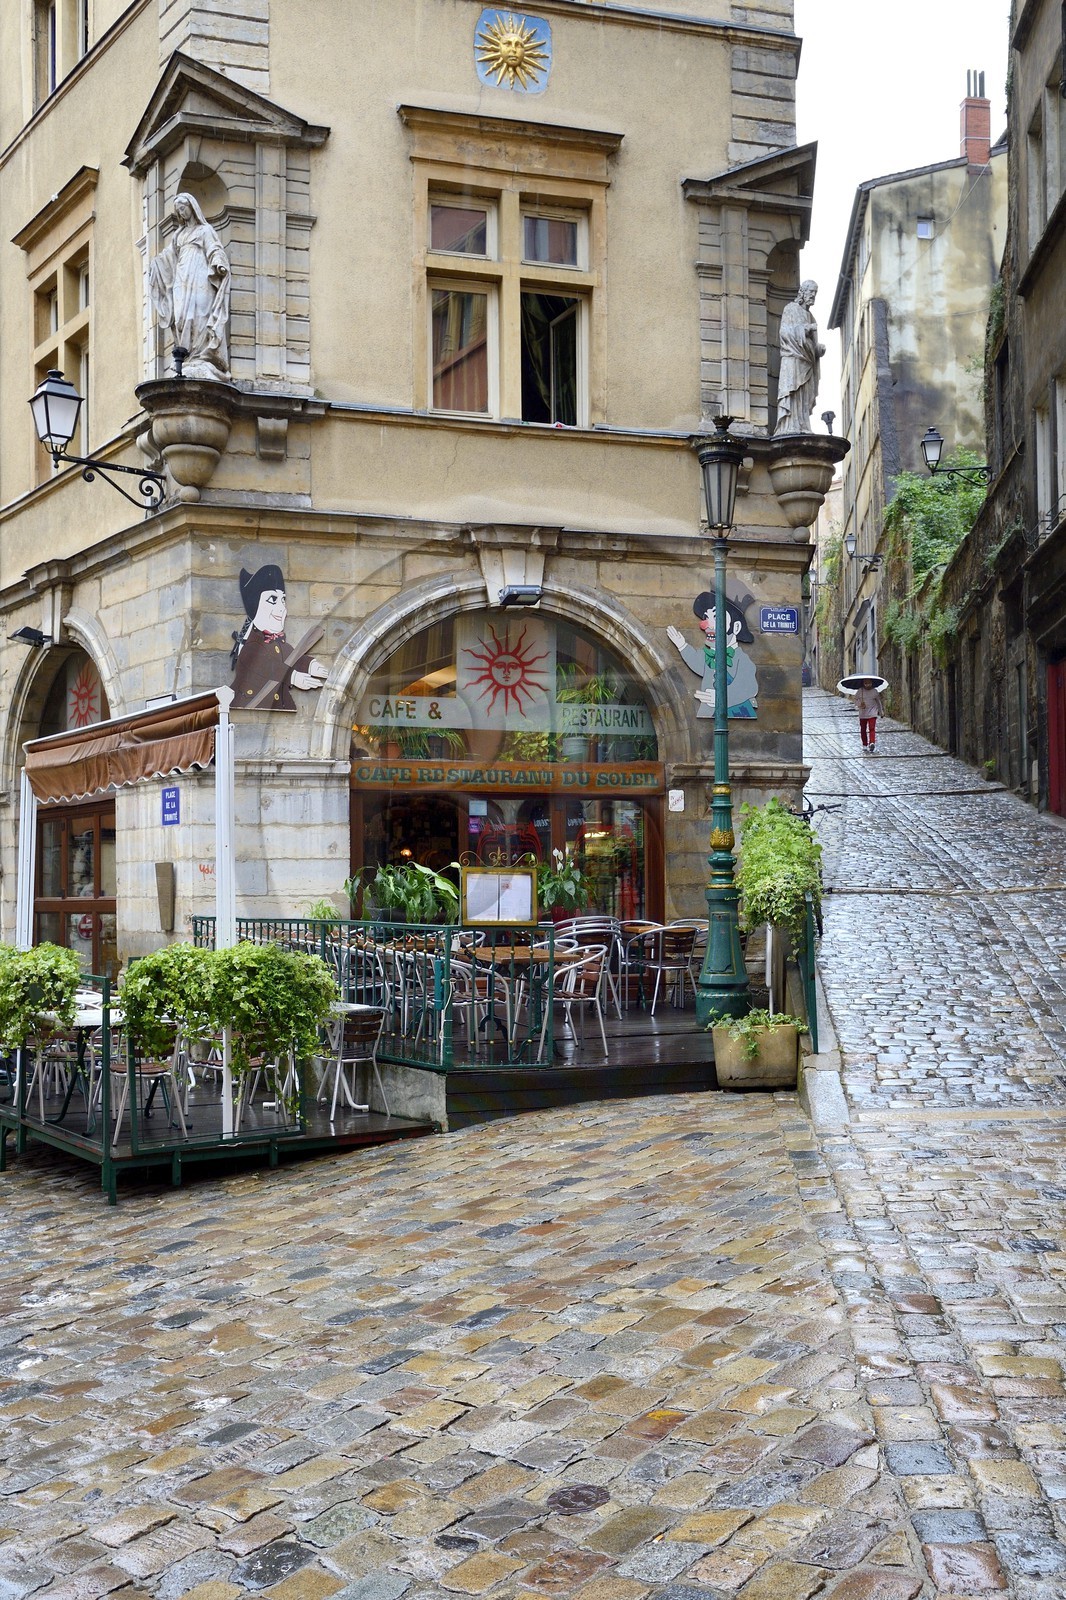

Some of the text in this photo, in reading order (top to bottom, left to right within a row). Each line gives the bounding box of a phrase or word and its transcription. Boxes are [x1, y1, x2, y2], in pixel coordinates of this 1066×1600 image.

[369, 699, 646, 728] CAFE & RESTAURANT
[356, 767, 660, 788] CAFE RESTAURANT DU SOLEIL
[166, 790, 176, 799] PLACE
